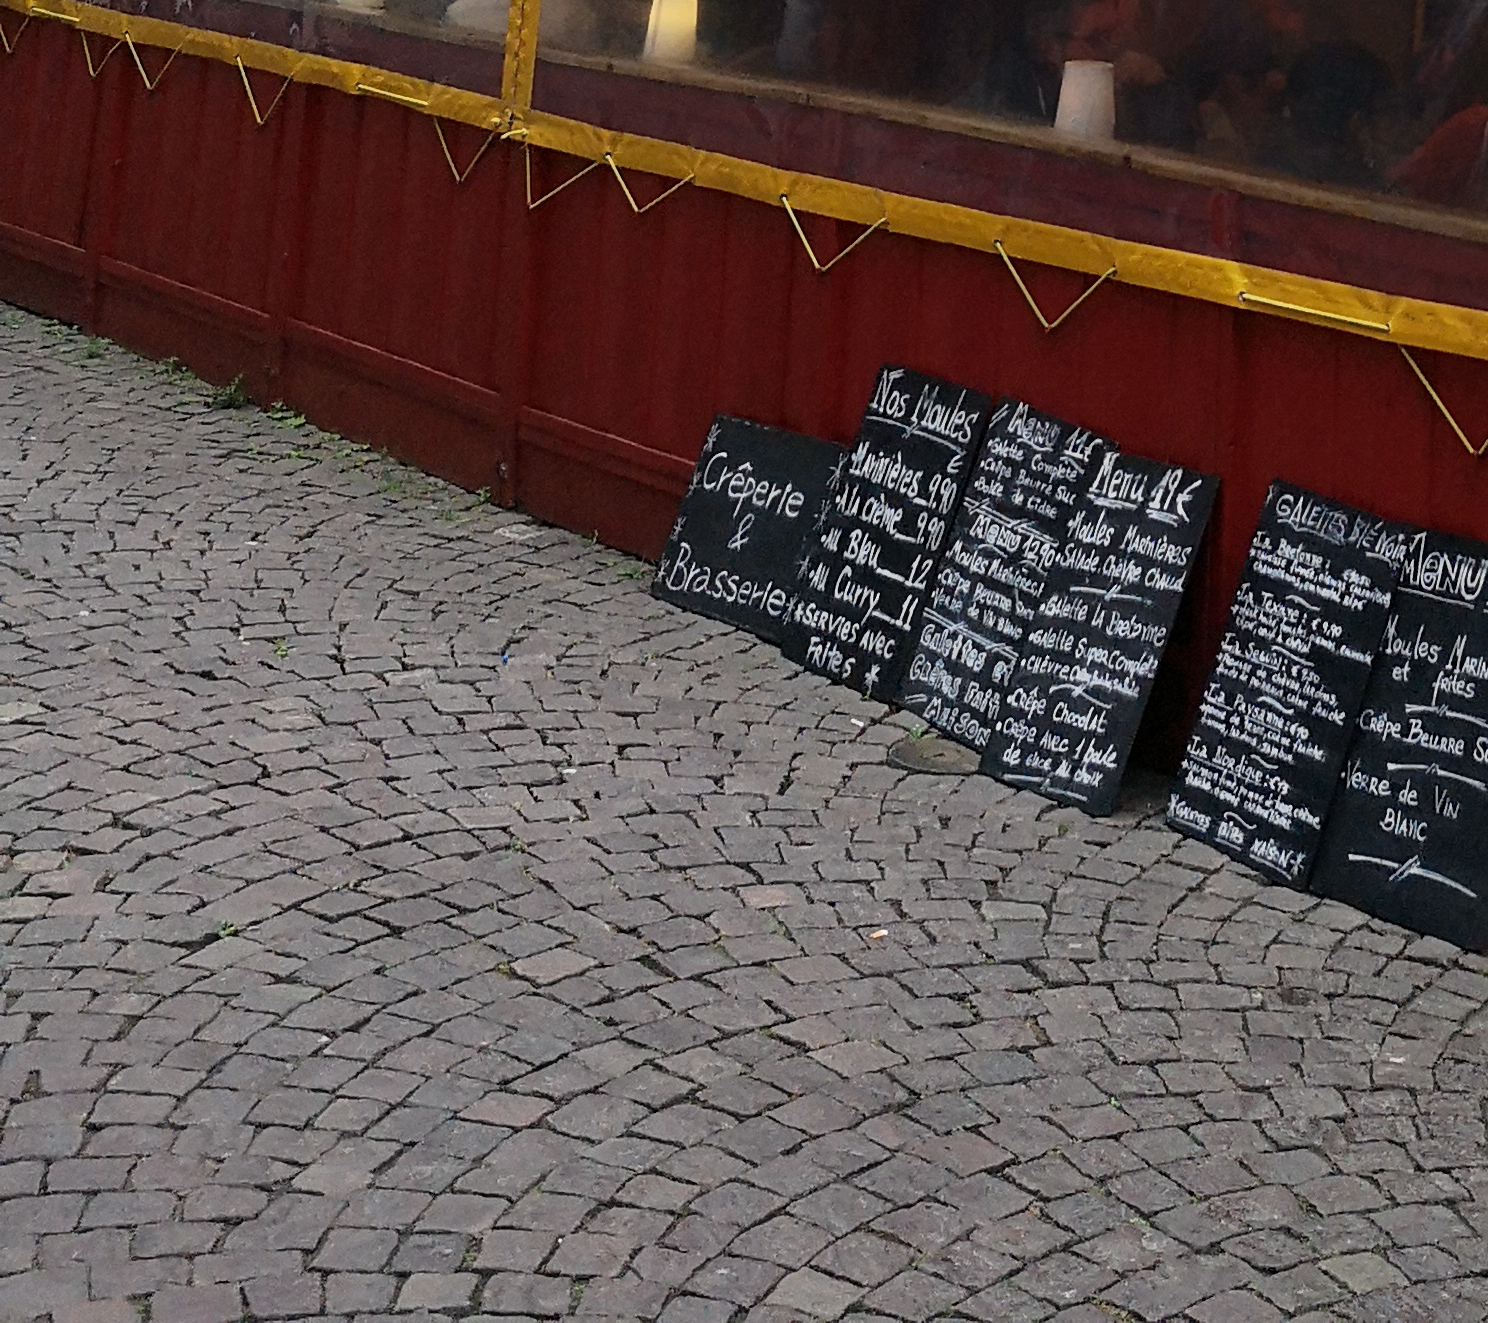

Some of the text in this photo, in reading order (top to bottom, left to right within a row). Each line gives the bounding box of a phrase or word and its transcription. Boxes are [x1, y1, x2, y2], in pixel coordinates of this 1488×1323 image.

[870, 369, 979, 443] Nos Moules
[703, 452, 805, 519] Crêperie
[844, 529, 881, 571] Bleu
[666, 541, 787, 617] Brasserie
[835, 565, 880, 631] Curry
[1381, 615, 1441, 663] Moules
[1393, 662, 1410, 681] et
[1398, 779, 1418, 805] de
